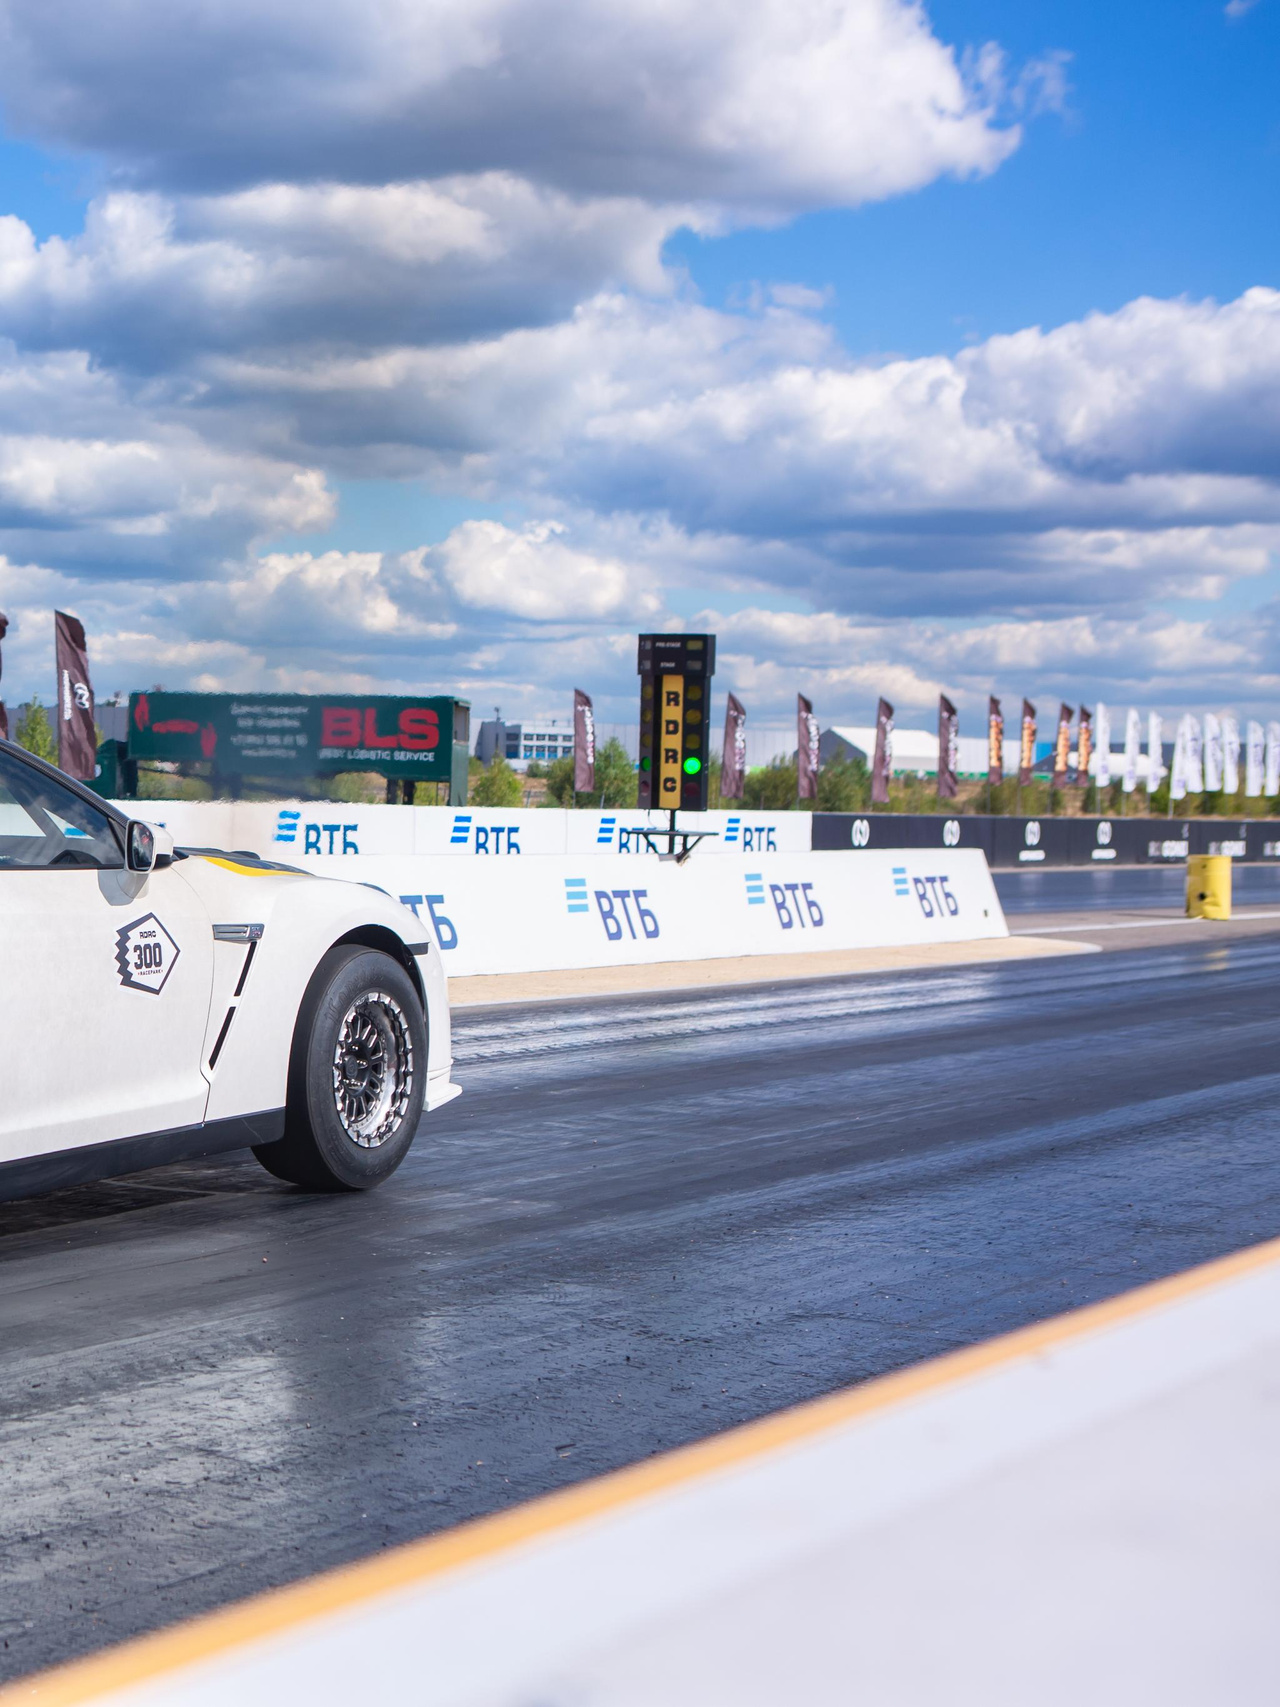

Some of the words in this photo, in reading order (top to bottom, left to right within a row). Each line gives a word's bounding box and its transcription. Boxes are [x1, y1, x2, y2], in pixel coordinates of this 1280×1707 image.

[322, 705, 440, 750] BLS
[347, 748, 392, 761] LOGISTIC
[393, 750, 435, 762] SERVICE
[304, 823, 360, 855] ВТБ
[475, 827, 521, 855] ВТБ
[743, 826, 777, 853] ВТБ
[594, 889, 661, 941] ВТБ
[769, 882, 824, 930] ВТБ
[912, 876, 959, 918] ВТБ
[399, 894, 458, 950] ТБ
[133, 942, 163, 970] 300
